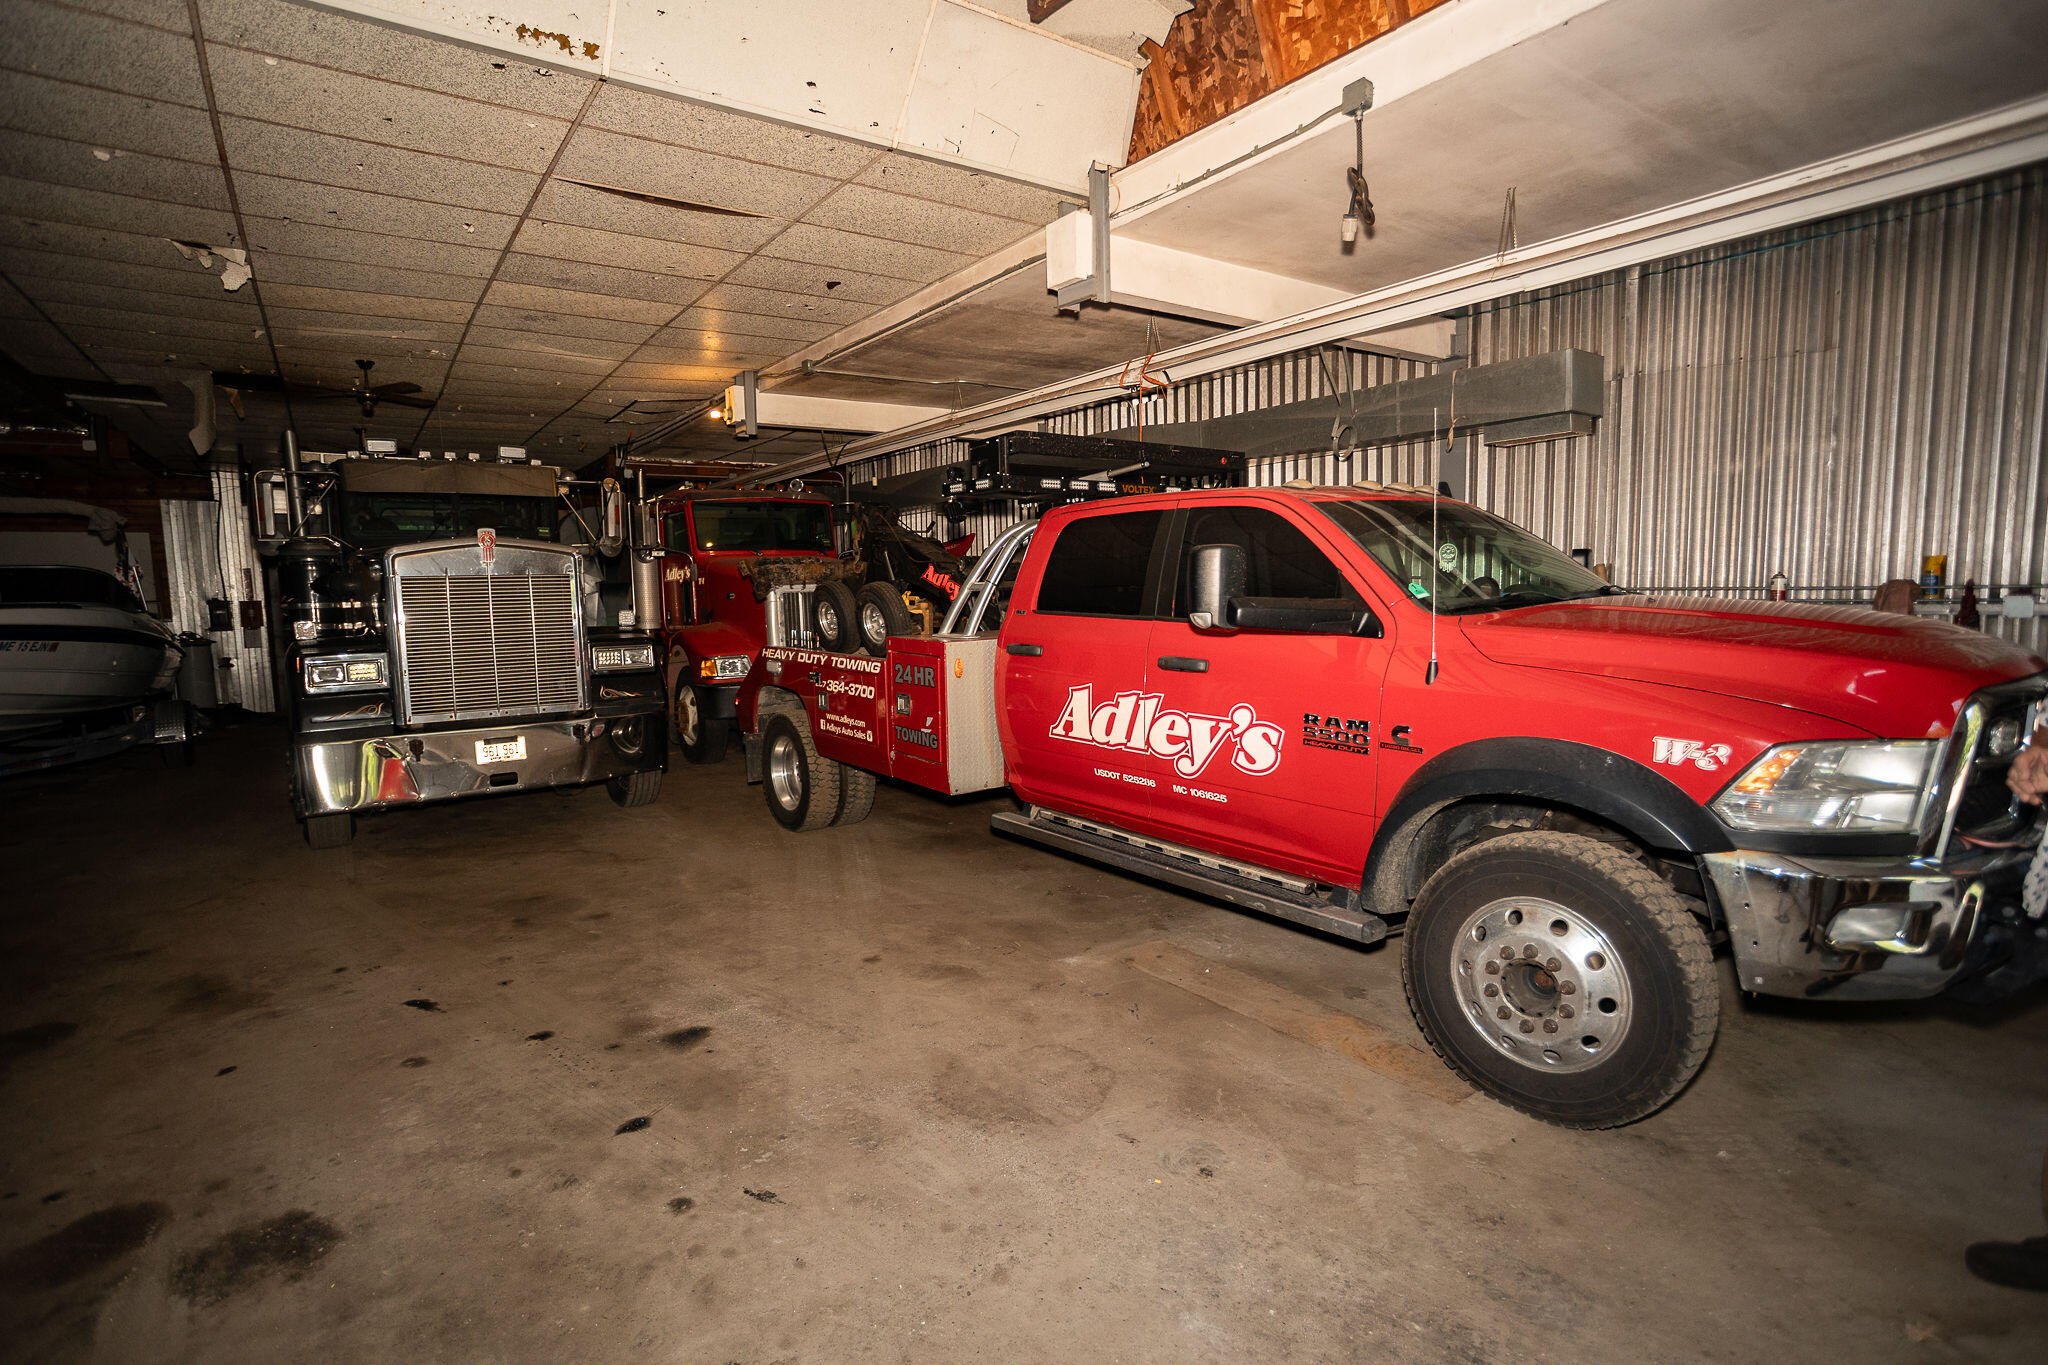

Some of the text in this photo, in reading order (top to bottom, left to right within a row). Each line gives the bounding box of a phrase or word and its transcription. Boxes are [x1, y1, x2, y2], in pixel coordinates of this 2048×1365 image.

[1122, 484, 1155, 493] VOLTEX
[665, 565, 691, 583] Adley's
[762, 648, 881, 674] HEAVY DUTY TOWING
[894, 663, 935, 688] 24 HR
[826, 679, 875, 699] 364-3700
[826, 712, 866, 728] www.adleys.com
[1303, 713, 1371, 733] RAM
[826, 723, 867, 740] Adleys Auto Sales
[895, 725, 938, 749] TOWING
[1049, 683, 1286, 779] Adley's
[1303, 726, 1370, 746] 5500
[482, 743, 519, 758] 961 961
[1304, 740, 1368, 754] HEAVY DUTY
[1652, 736, 1731, 771] W-3
[1094, 767, 1121, 780] USDOT
[1173, 784, 1228, 804] MC 1061625
